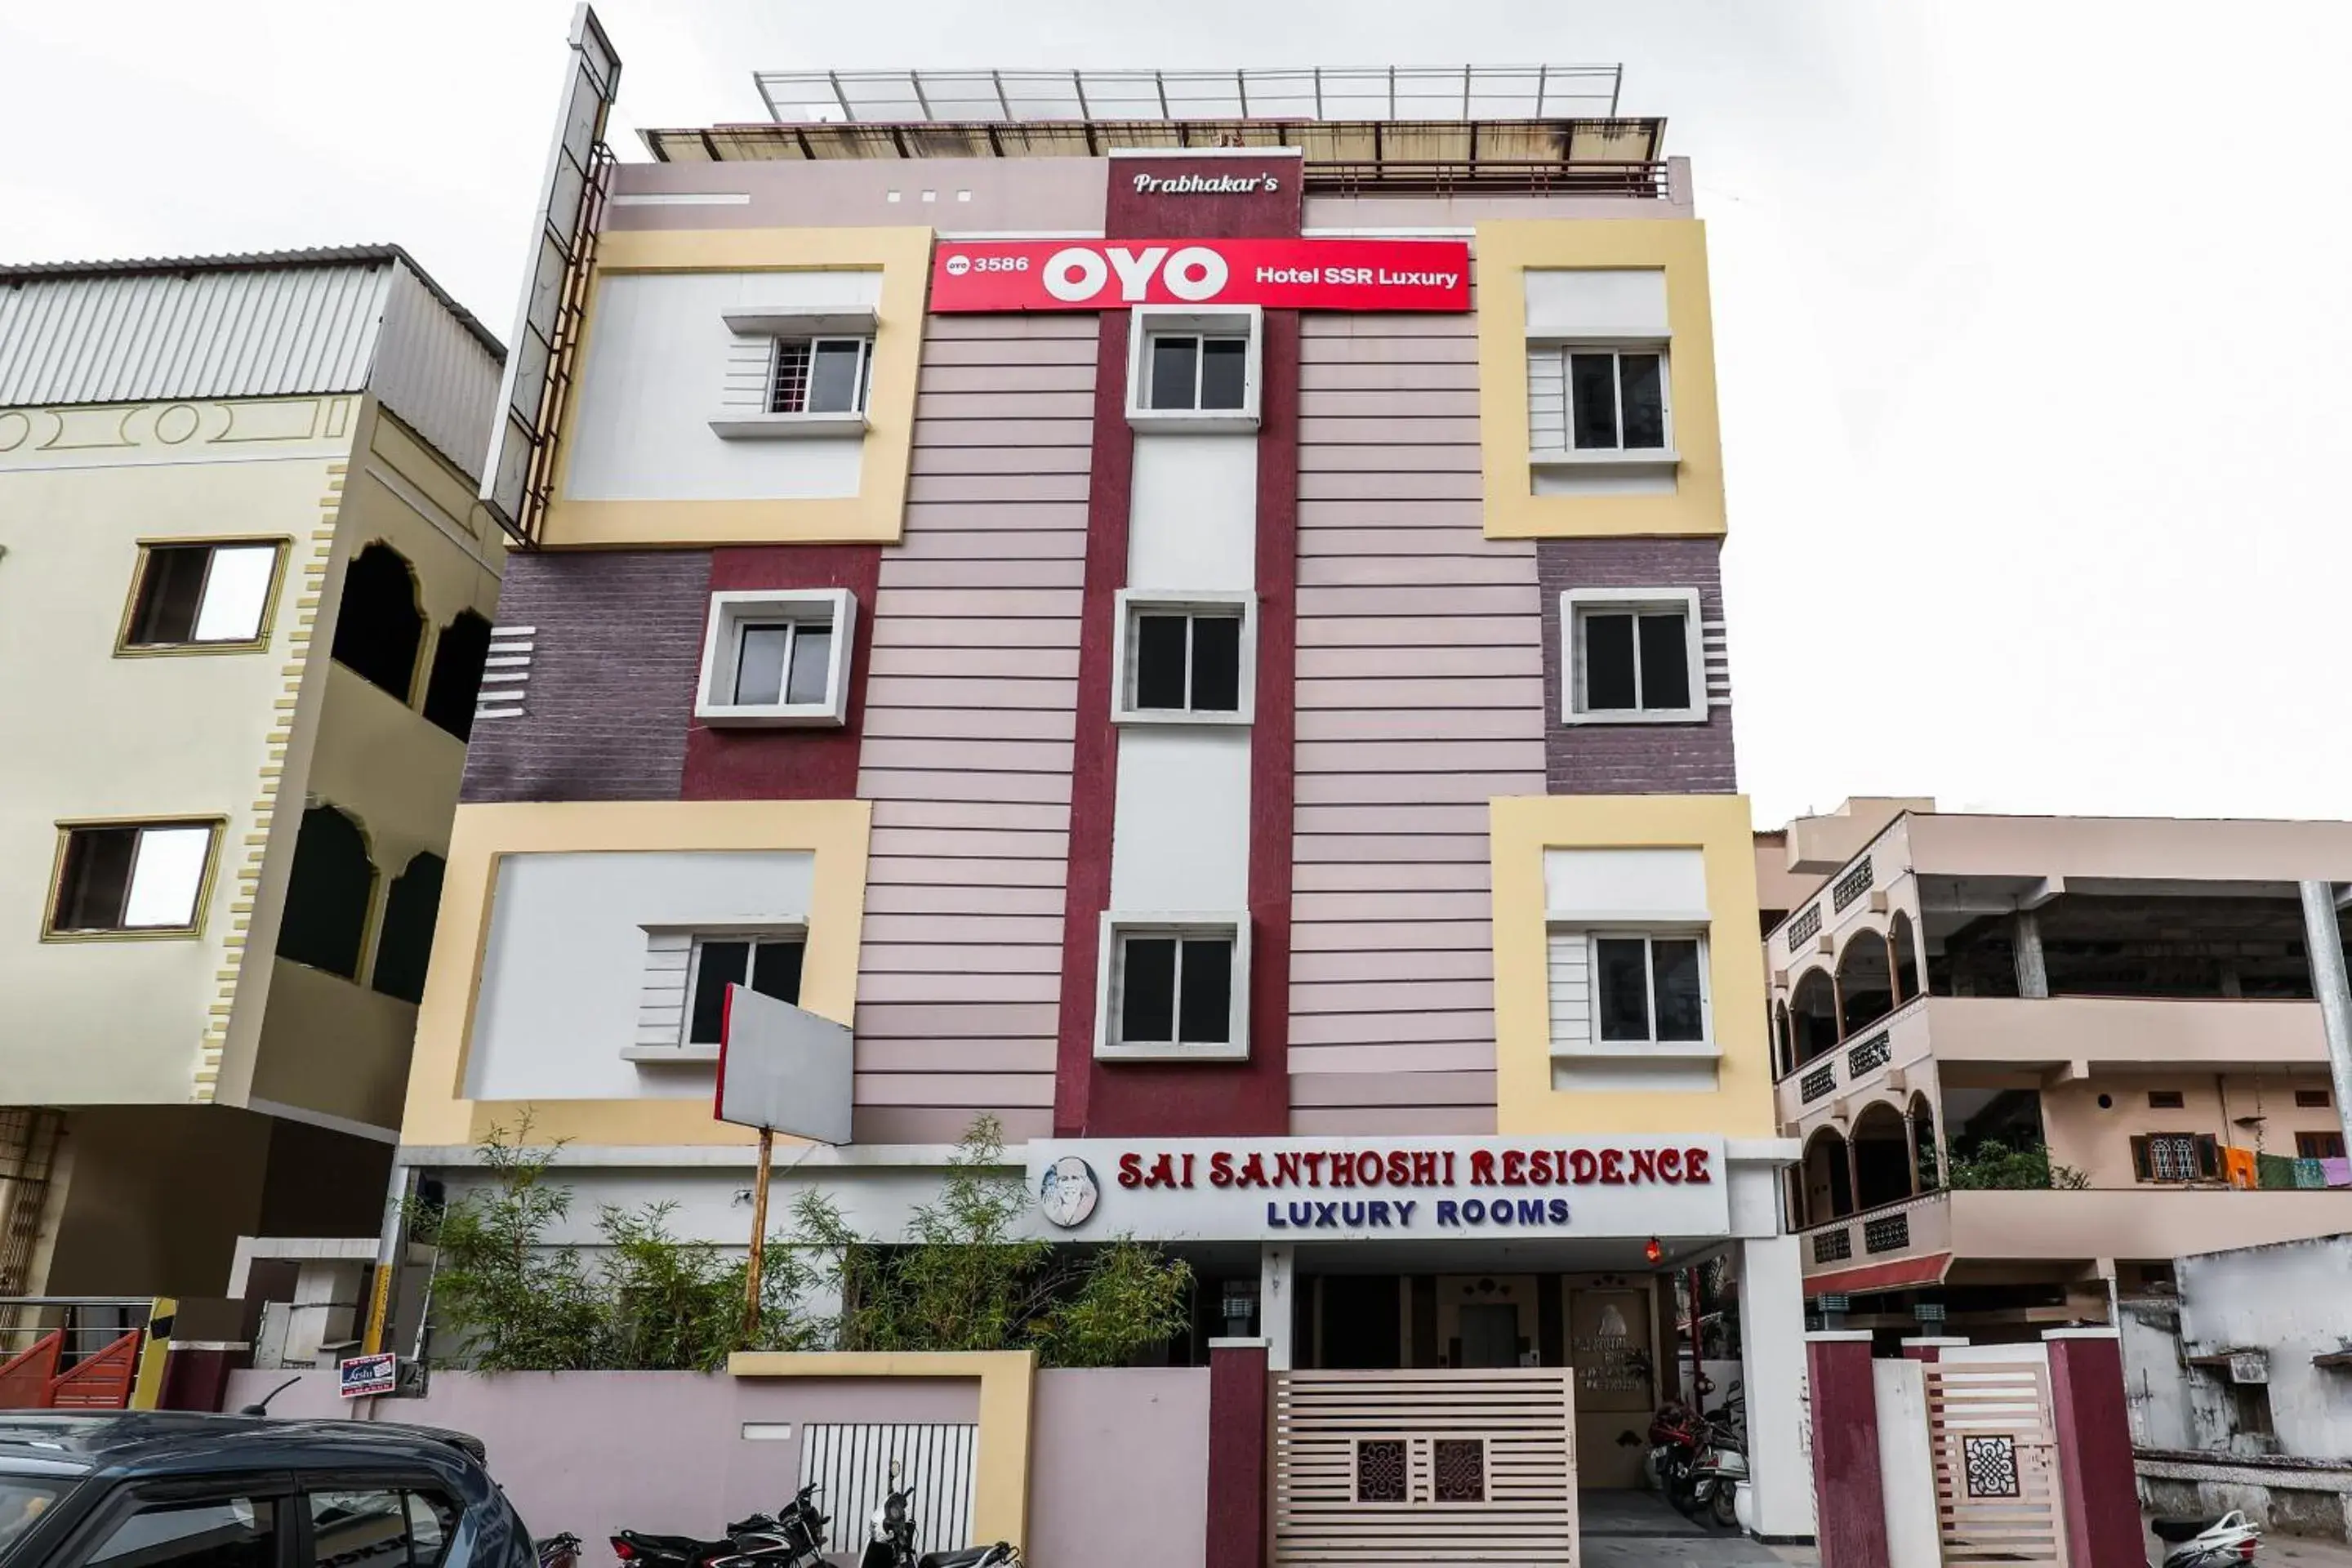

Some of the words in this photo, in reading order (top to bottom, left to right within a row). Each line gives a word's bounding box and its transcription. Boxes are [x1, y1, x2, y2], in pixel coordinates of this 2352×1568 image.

[1134, 173, 1278, 193] Prabhakar's
[974, 256, 1029, 272] 3586
[1043, 247, 1228, 302] OYO
[1255, 266, 1320, 285] Hotel
[1324, 268, 1374, 286] SSR
[1379, 268, 1459, 290] Luxury
[1118, 1153, 1194, 1188] SAI
[1209, 1151, 1454, 1188] SANTHOSHI
[1471, 1148, 1710, 1186] RESIDENCE
[1267, 1200, 1416, 1227] LUXURY
[1437, 1199, 1570, 1226] ROOMS
